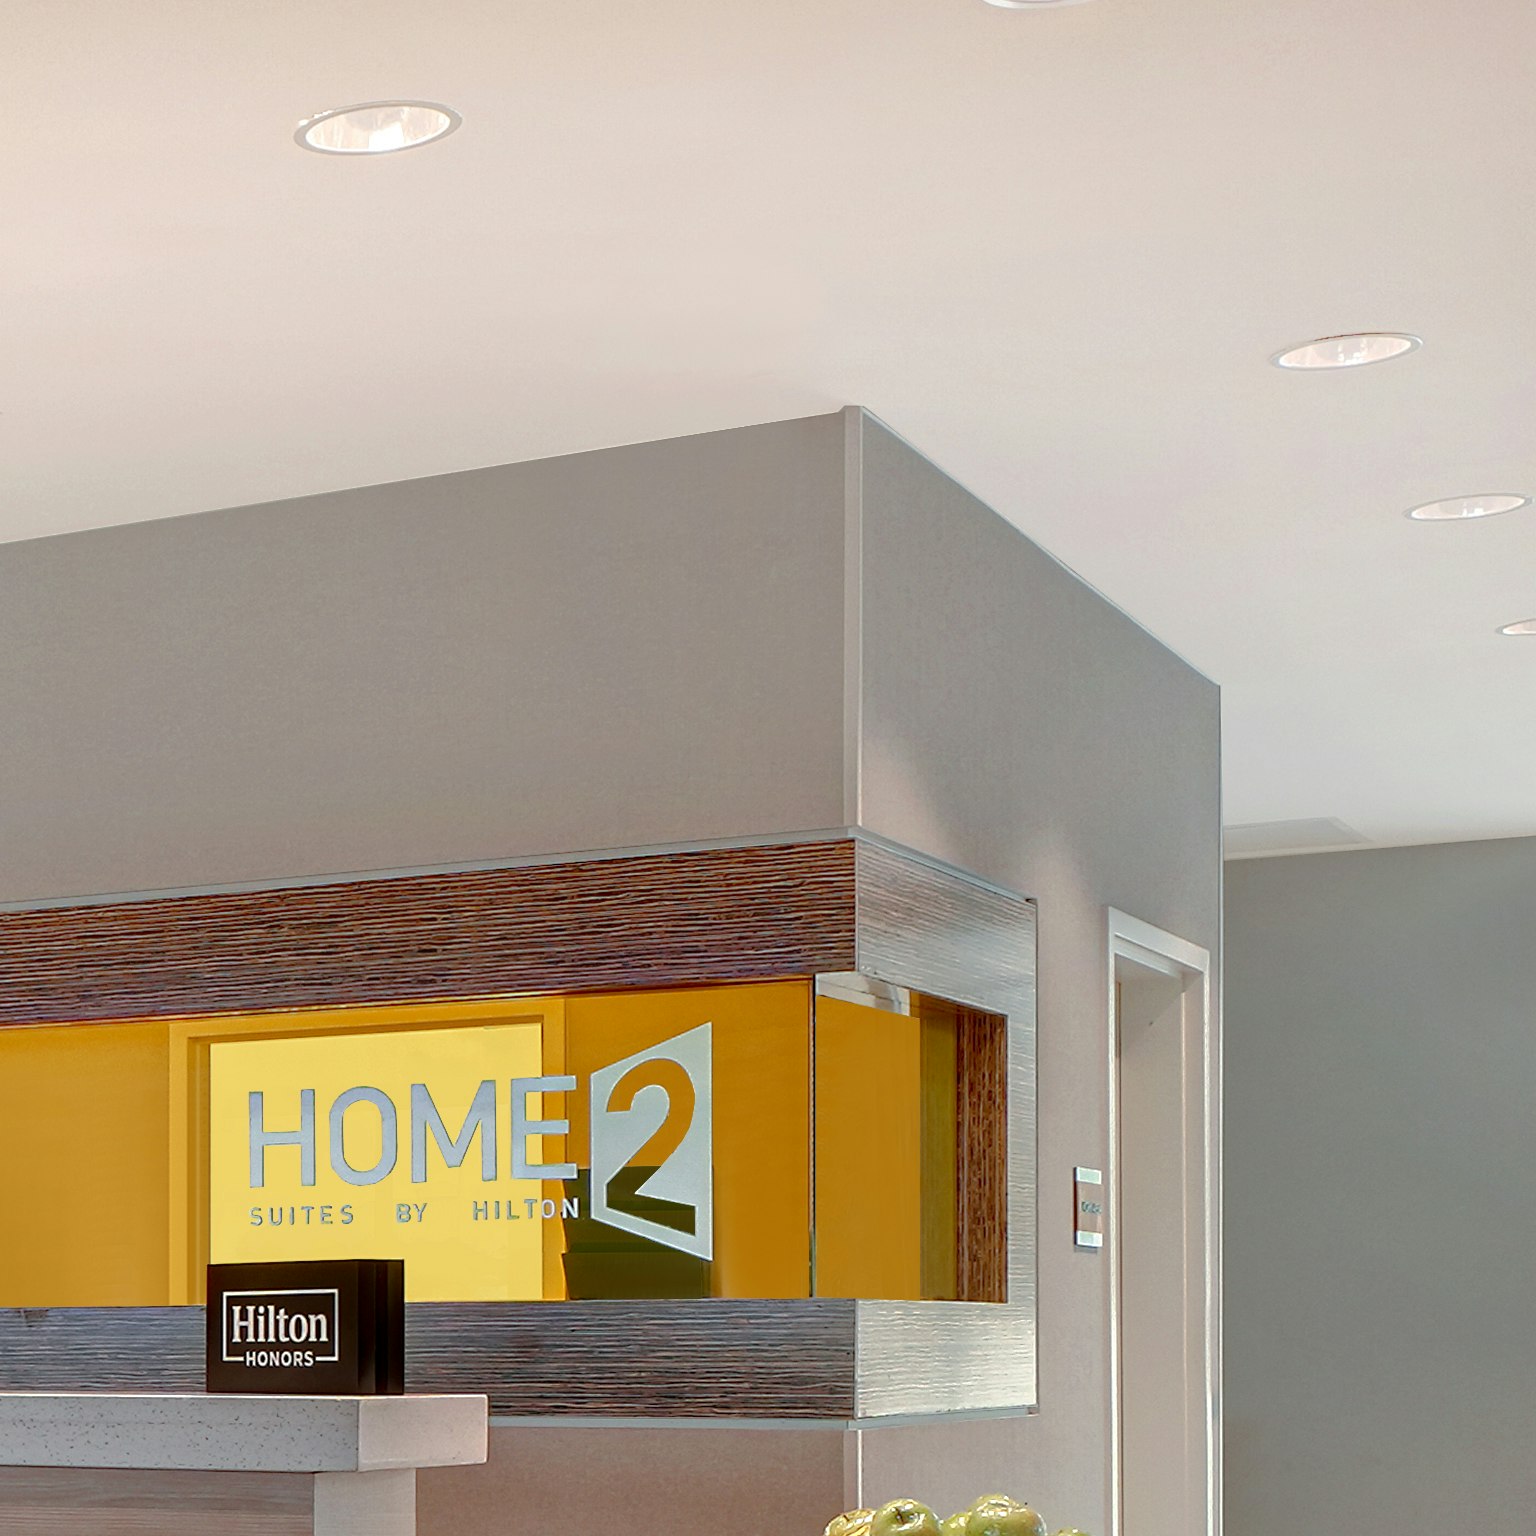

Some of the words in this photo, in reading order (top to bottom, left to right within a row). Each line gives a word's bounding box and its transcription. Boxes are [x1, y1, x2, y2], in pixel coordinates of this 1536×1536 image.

[249, 1075, 578, 1188] HOME
[249, 1204, 354, 1226] SUITES
[396, 1203, 428, 1223] BY
[473, 1197, 580, 1220] HILTON
[232, 1305, 329, 1343] Hilton
[246, 1351, 314, 1367] HONORS
